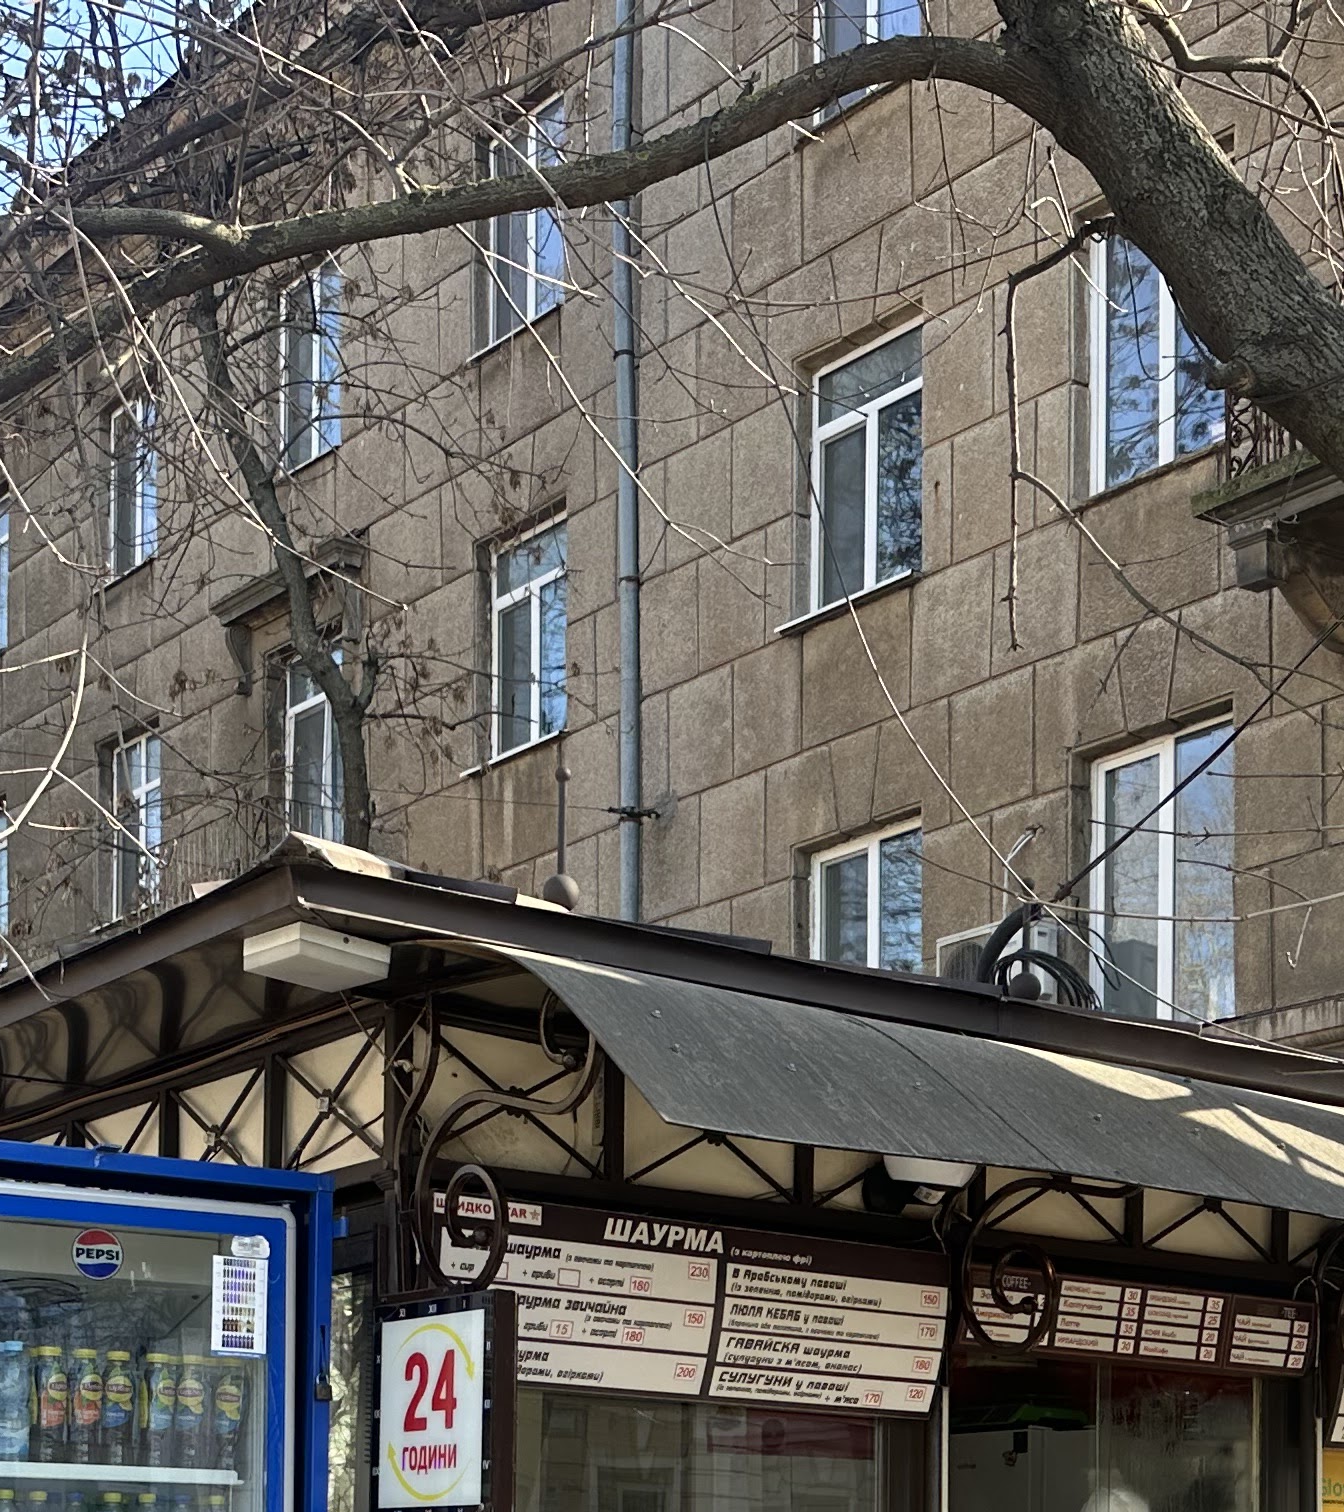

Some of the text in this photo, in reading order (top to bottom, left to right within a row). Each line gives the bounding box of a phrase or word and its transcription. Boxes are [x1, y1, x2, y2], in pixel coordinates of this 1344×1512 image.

[436, 1198, 526, 1219] ШИДКО AR
[604, 1218, 724, 1254] ШАУРМА
[76, 1247, 120, 1261] PEPSI
[506, 1241, 561, 1259] шаурма
[690, 1266, 708, 1278] 230
[517, 1292, 627, 1316] аурма звичайна
[686, 1312, 703, 1324] 150
[766, 1307, 801, 1321] КЕБАБ
[556, 1324, 568, 1334] 15
[920, 1326, 935, 1337] 170
[518, 1350, 548, 1364] урма
[803, 1344, 850, 1359] шаурма
[677, 1367, 695, 1379] 200
[719, 1371, 793, 1387] СУЛУГУНИ
[403, 1349, 457, 1432] 24
[909, 1388, 923, 1399] 120
[864, 1393, 880, 1404] 170
[402, 1444, 457, 1475] ГОДИНИ
